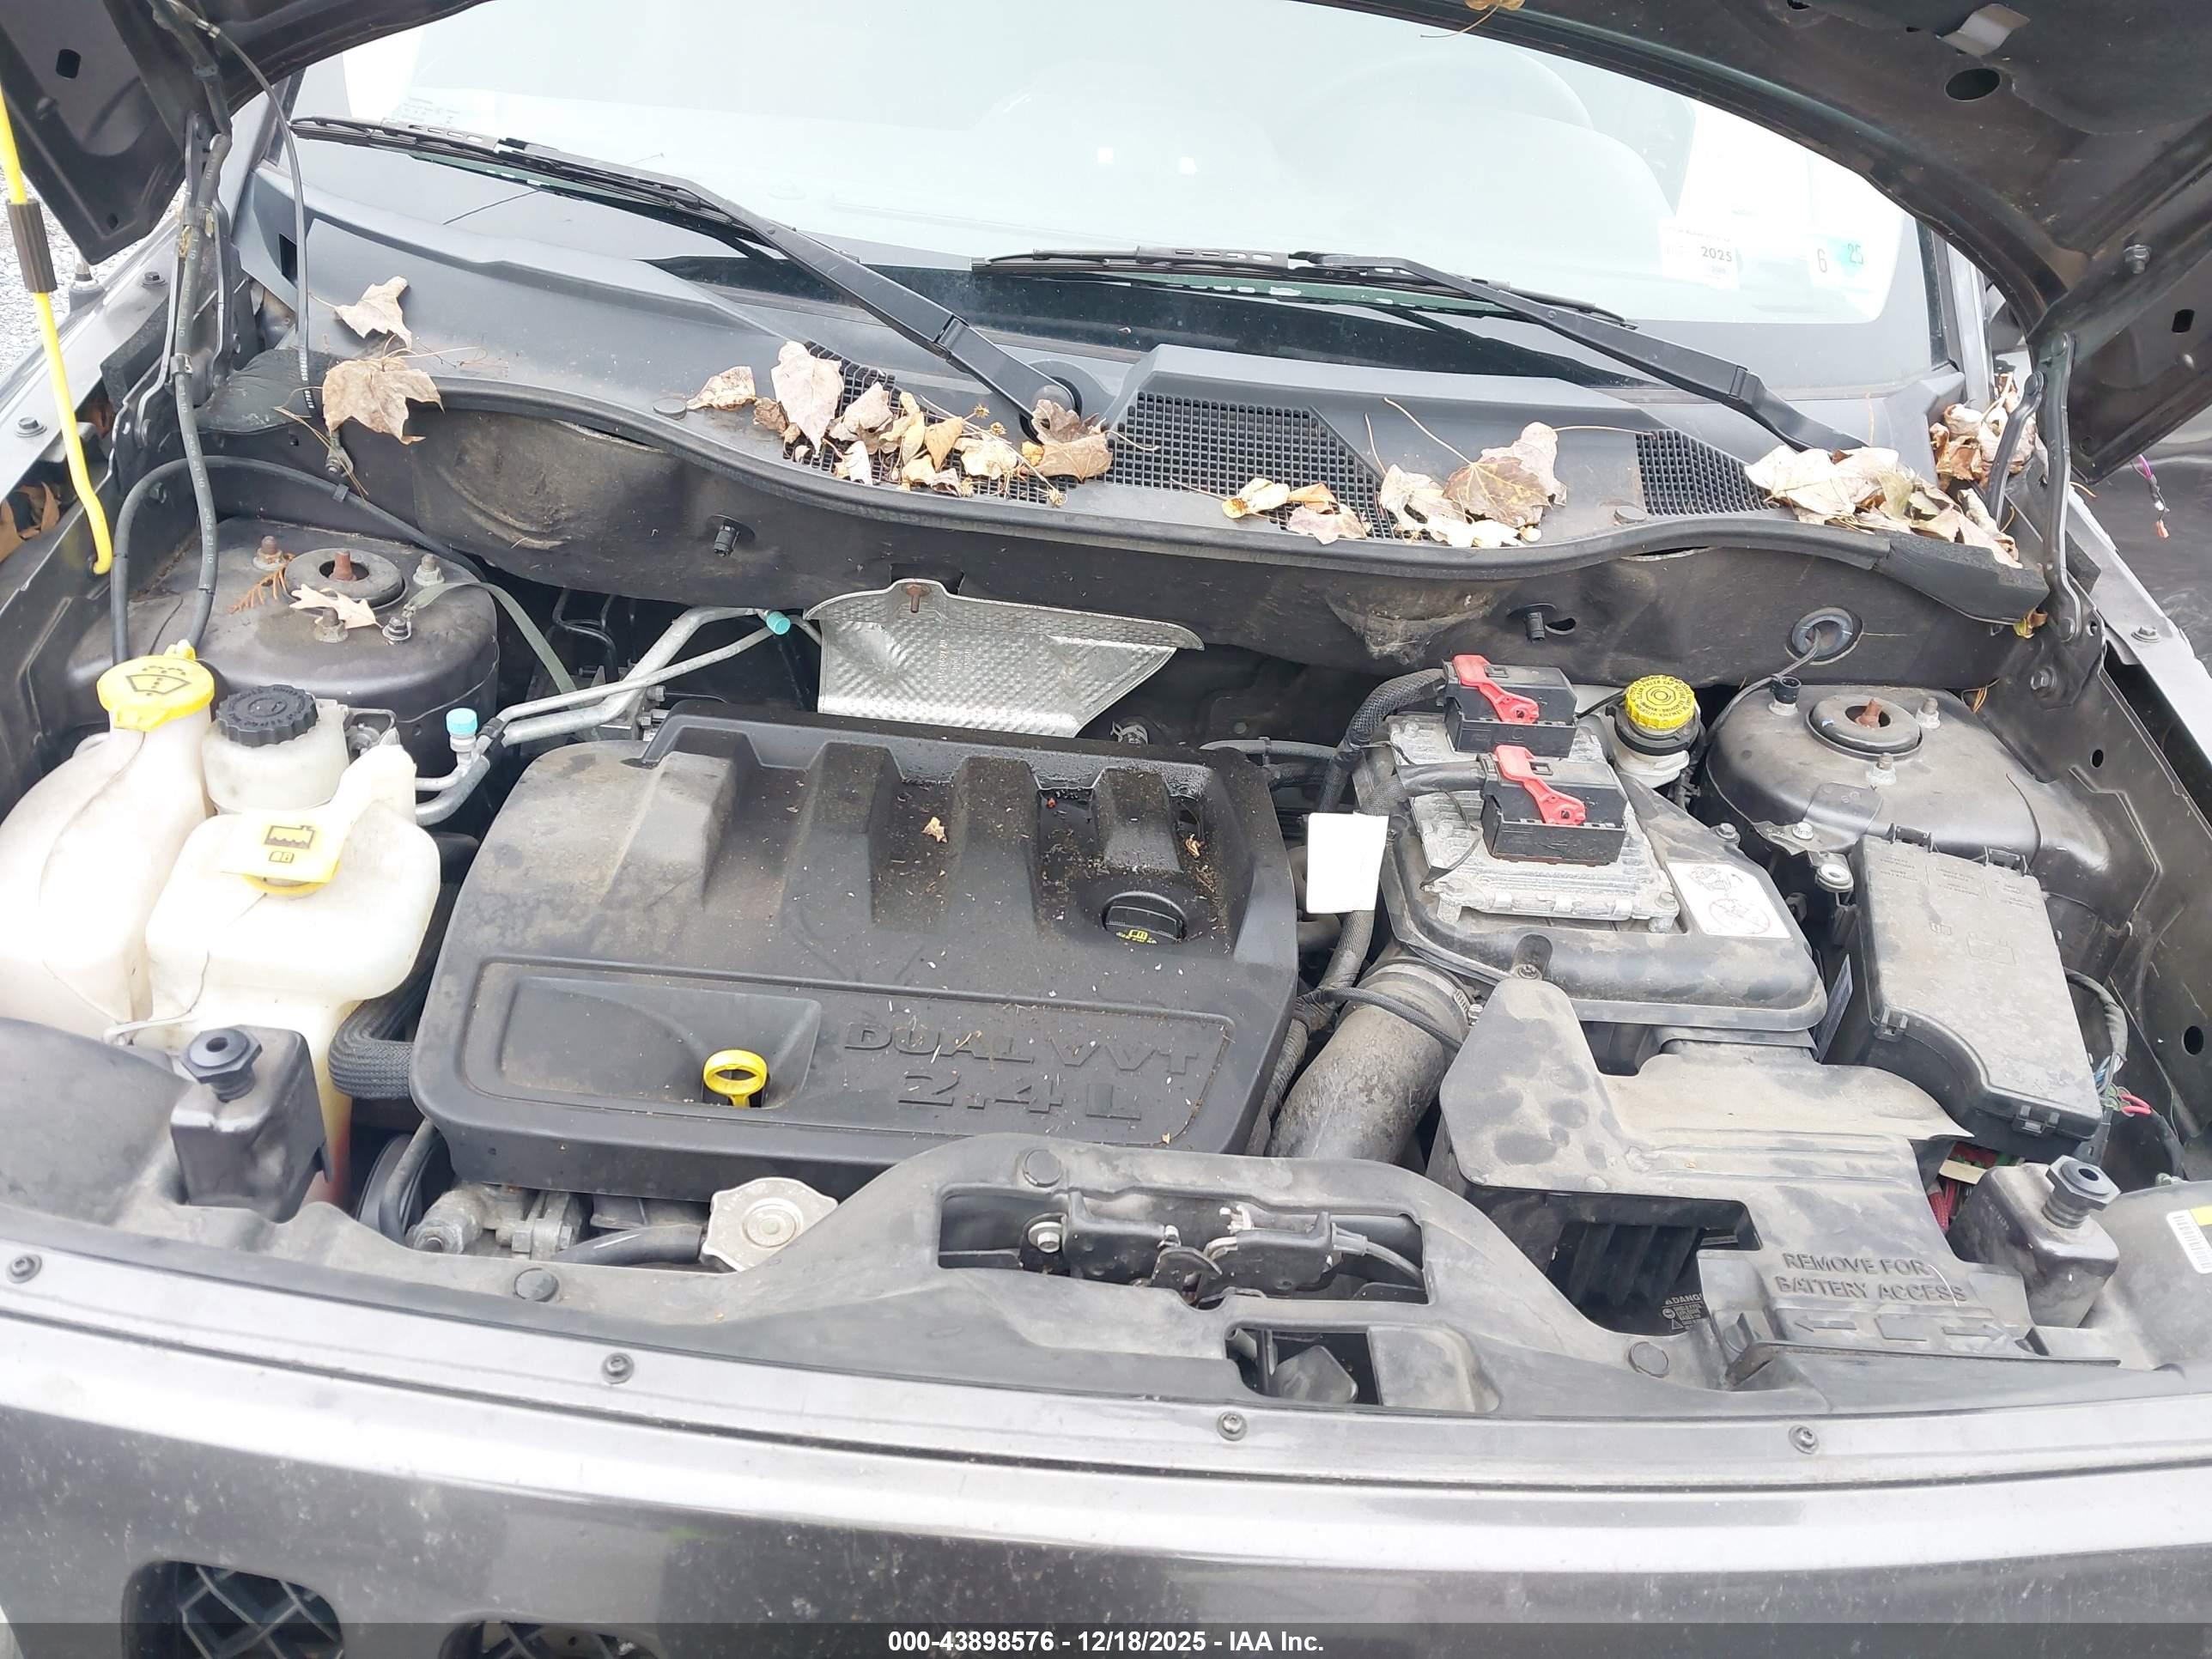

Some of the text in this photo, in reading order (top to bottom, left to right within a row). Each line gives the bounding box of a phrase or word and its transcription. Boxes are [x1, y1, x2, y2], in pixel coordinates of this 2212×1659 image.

[1700, 246, 1733, 262] 2025
[1816, 243, 1864, 273] 6 25
[844, 1023, 1199, 1075] DUAL VVT
[1782, 1251, 1931, 1277] REMOVE FOR
[1672, 1292, 1703, 1304] DANG
[1774, 1275, 1968, 1304] BATTERY ACCESS
